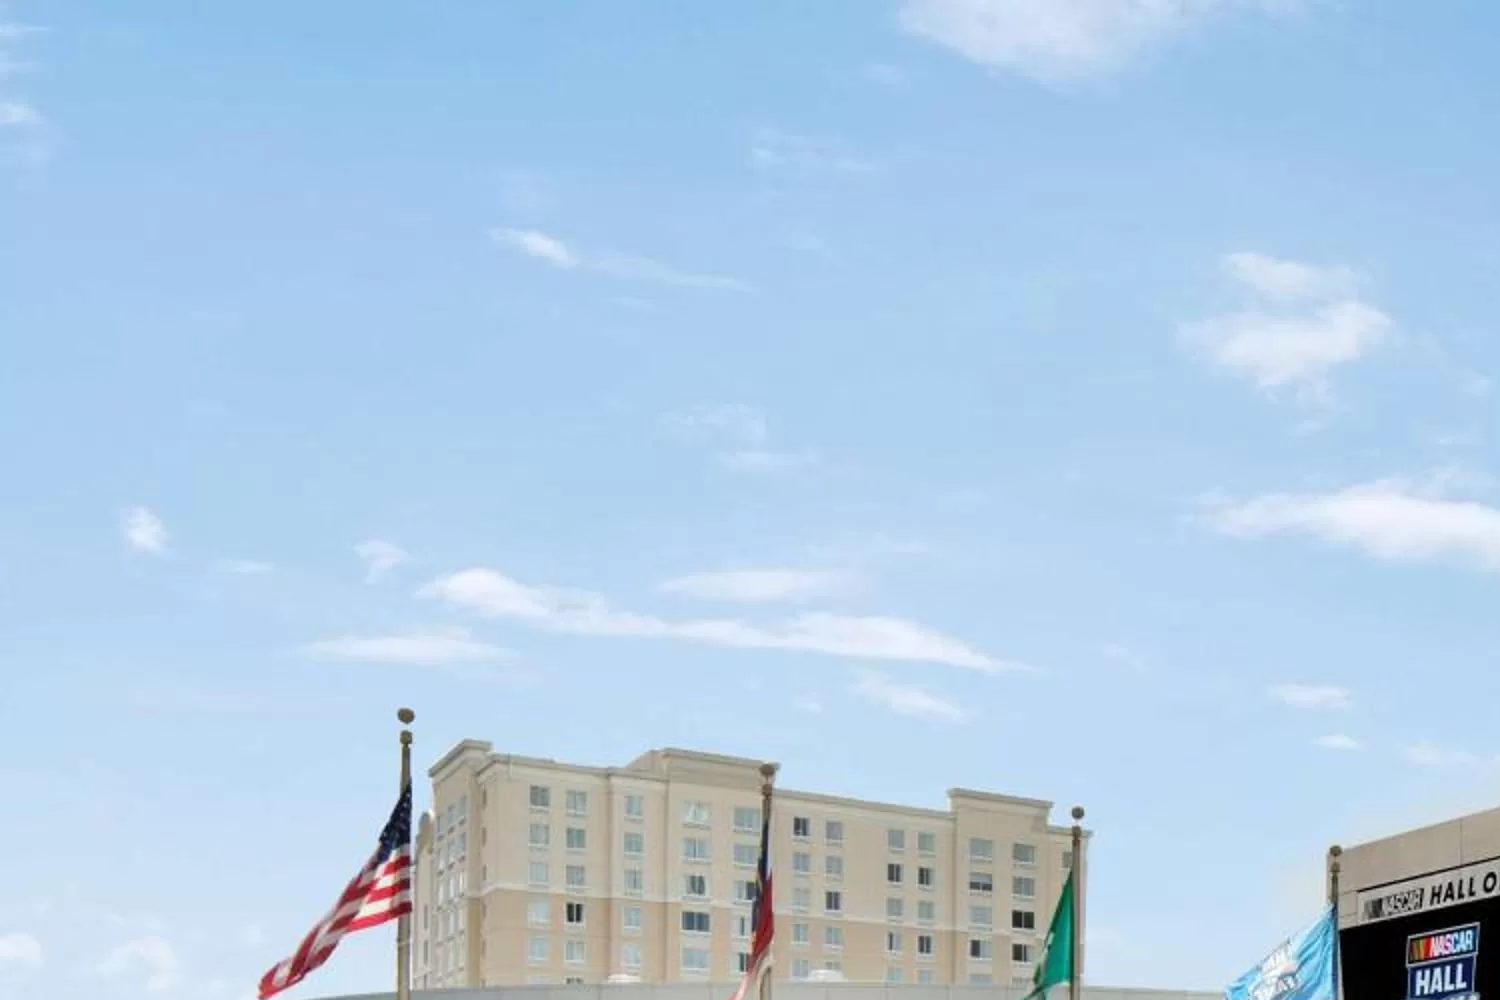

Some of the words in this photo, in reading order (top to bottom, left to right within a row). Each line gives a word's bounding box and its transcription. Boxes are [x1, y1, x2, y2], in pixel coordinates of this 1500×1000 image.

[1429, 876, 1476, 906] HALL
[1429, 930, 1474, 957] NASCAR
[1415, 963, 1467, 996] HALL
